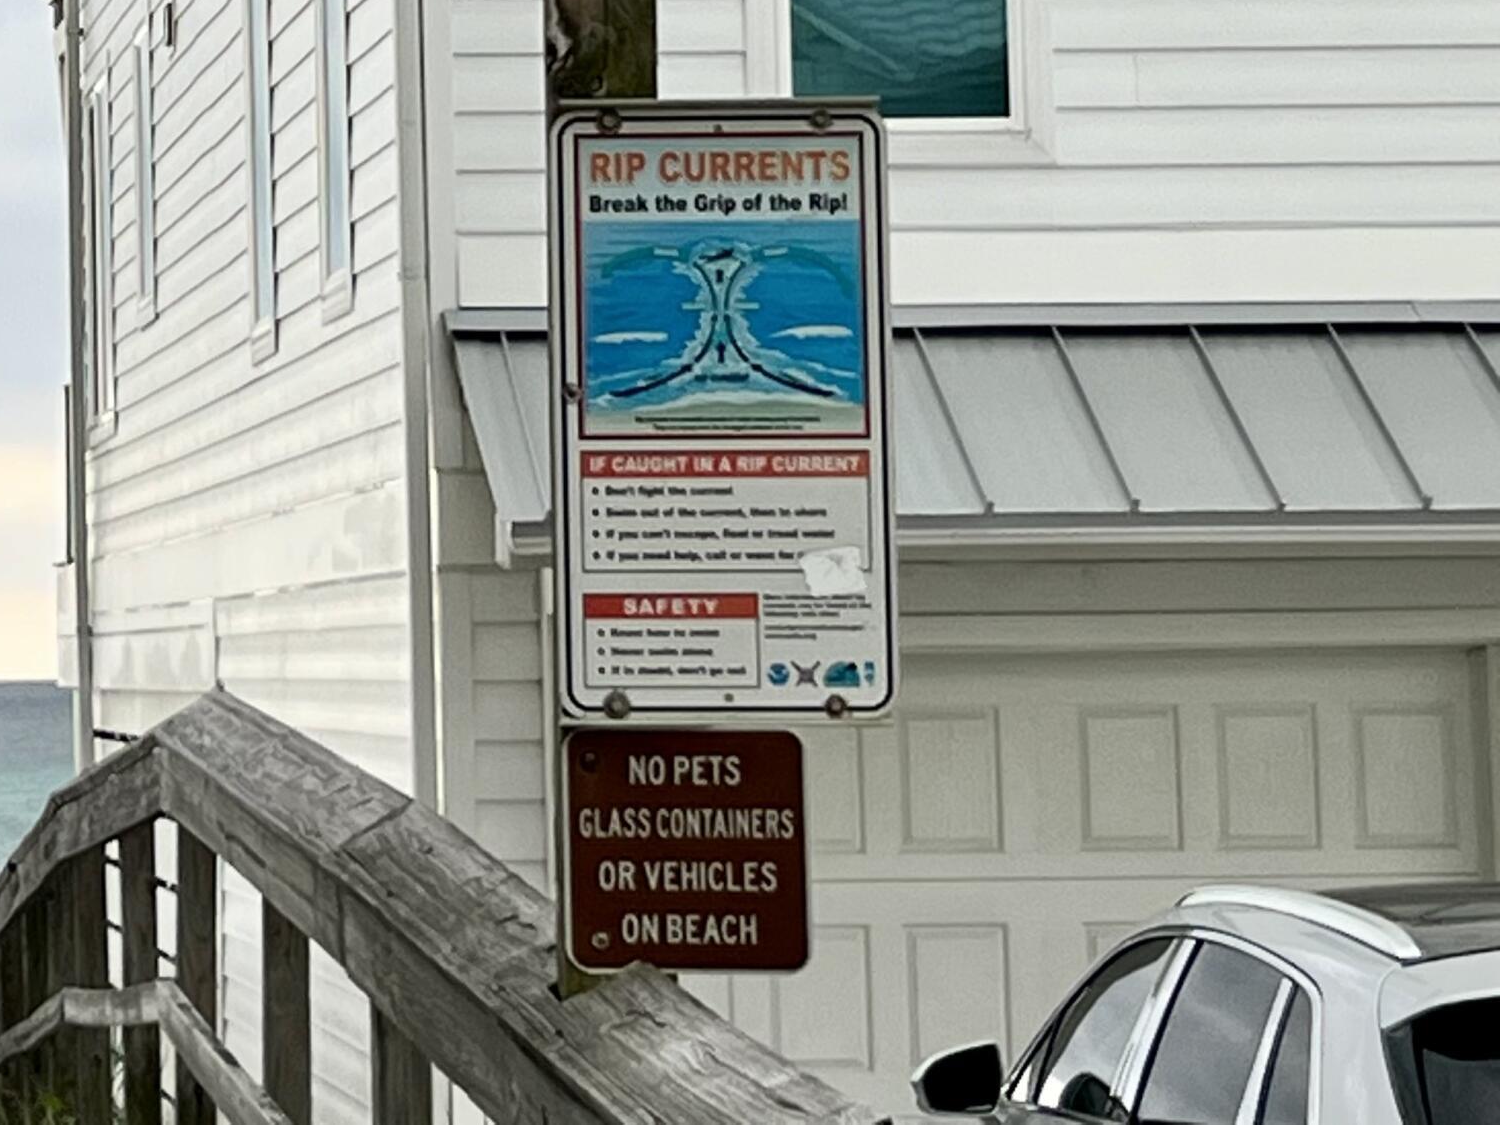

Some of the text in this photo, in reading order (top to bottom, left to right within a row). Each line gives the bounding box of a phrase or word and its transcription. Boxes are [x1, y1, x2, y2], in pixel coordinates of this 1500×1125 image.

[590, 150, 850, 182] RIP CURRENTS
[589, 193, 847, 215] Break the Grip of the Rip!
[590, 456, 860, 472] IF CAUGHT IN A RIP CURRENT
[623, 598, 719, 615] SAFETY
[628, 755, 742, 786] NO PETS
[579, 808, 795, 839] GLASS CONTAINERS
[598, 860, 778, 892] OR VEHICLES
[622, 913, 758, 944] ON BEACH
